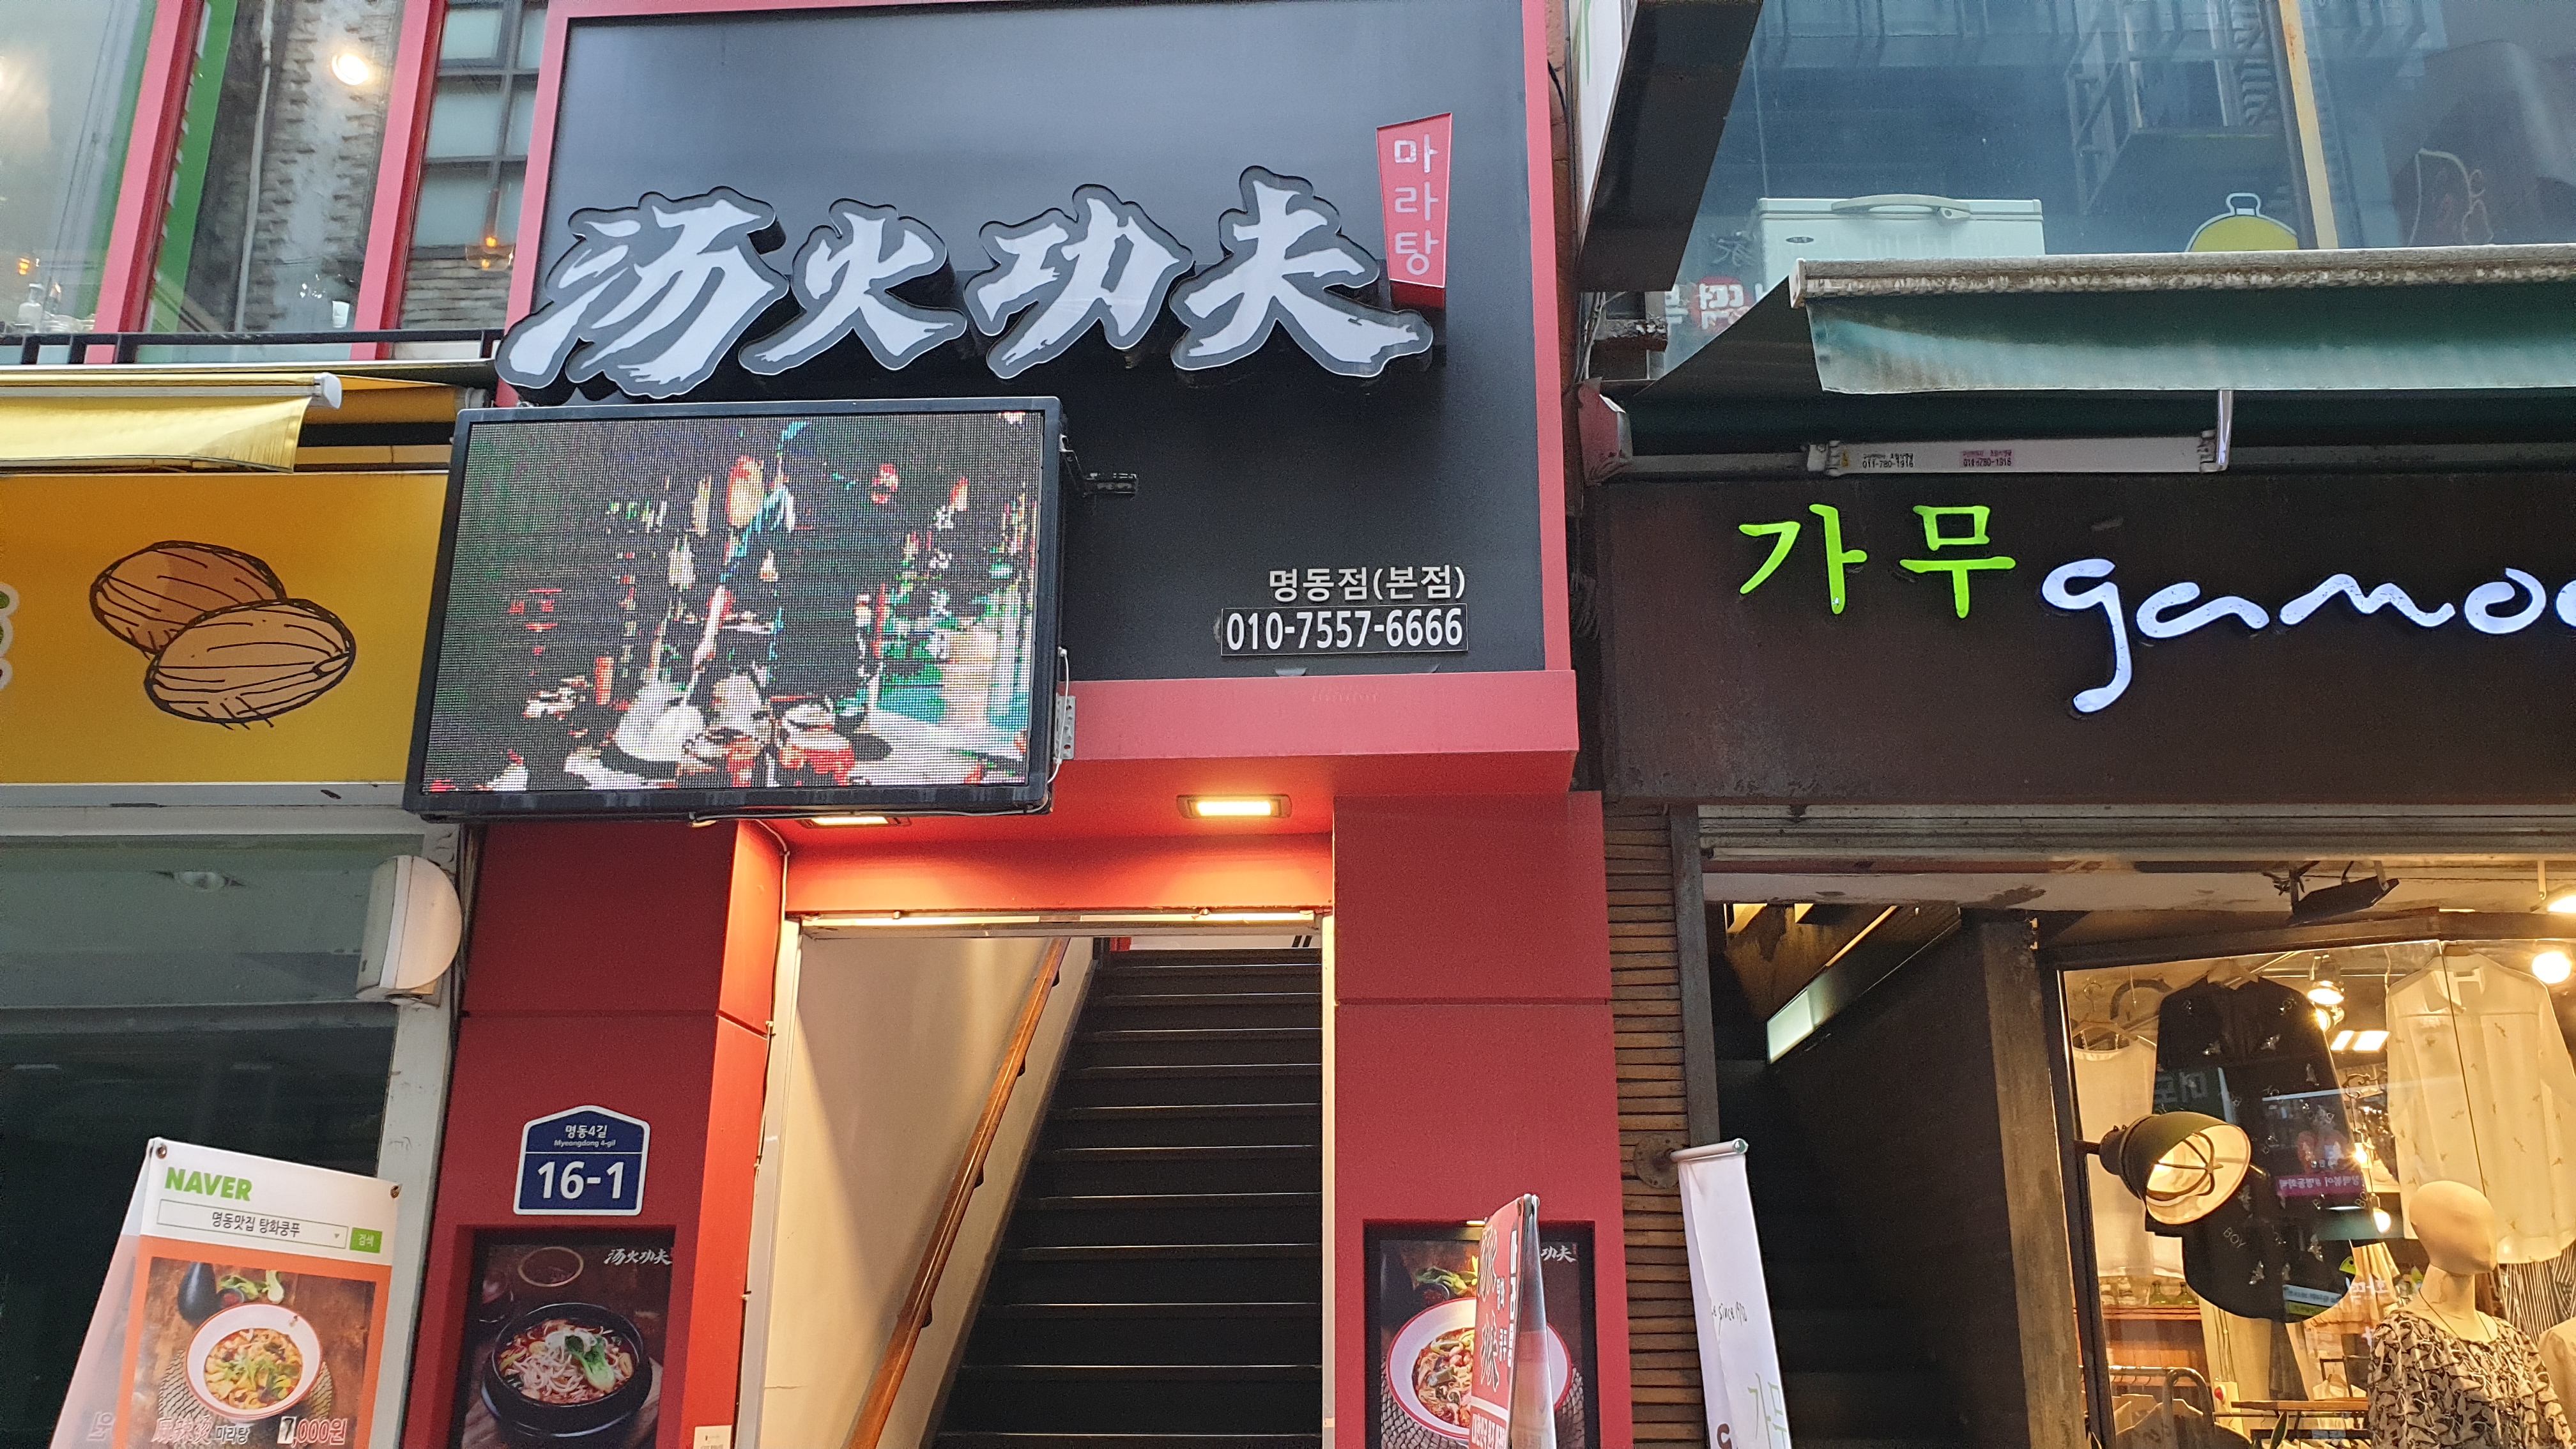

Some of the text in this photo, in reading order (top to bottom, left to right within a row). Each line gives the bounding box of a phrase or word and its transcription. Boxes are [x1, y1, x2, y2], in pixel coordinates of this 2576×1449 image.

[1394, 133, 1439, 275] 마라탕
[500, 169, 1431, 391] 汤火功夫
[1739, 503, 2016, 618] 가무
[1269, 564, 1466, 602] 명동점(본점)
[1226, 608, 1462, 650] 010-7557-6666
[2042, 558, 2576, 714] gamo
[554, 1139, 616, 1148] Myeongdong 4-gil
[565, 1124, 608, 1139] 명동4길
[164, 1167, 252, 1202] NAVER
[537, 1160, 625, 1200] 16-1
[212, 1211, 300, 1238] 명동맛집 탕화쿵푸
[358, 1234, 374, 1247] 검색
[2223, 1227, 2247, 1249] BOY
[603, 1248, 673, 1266] 汤火功夫
[215, 1425, 251, 1445] 마라탕
[278, 1416, 348, 1448] 7,000원
